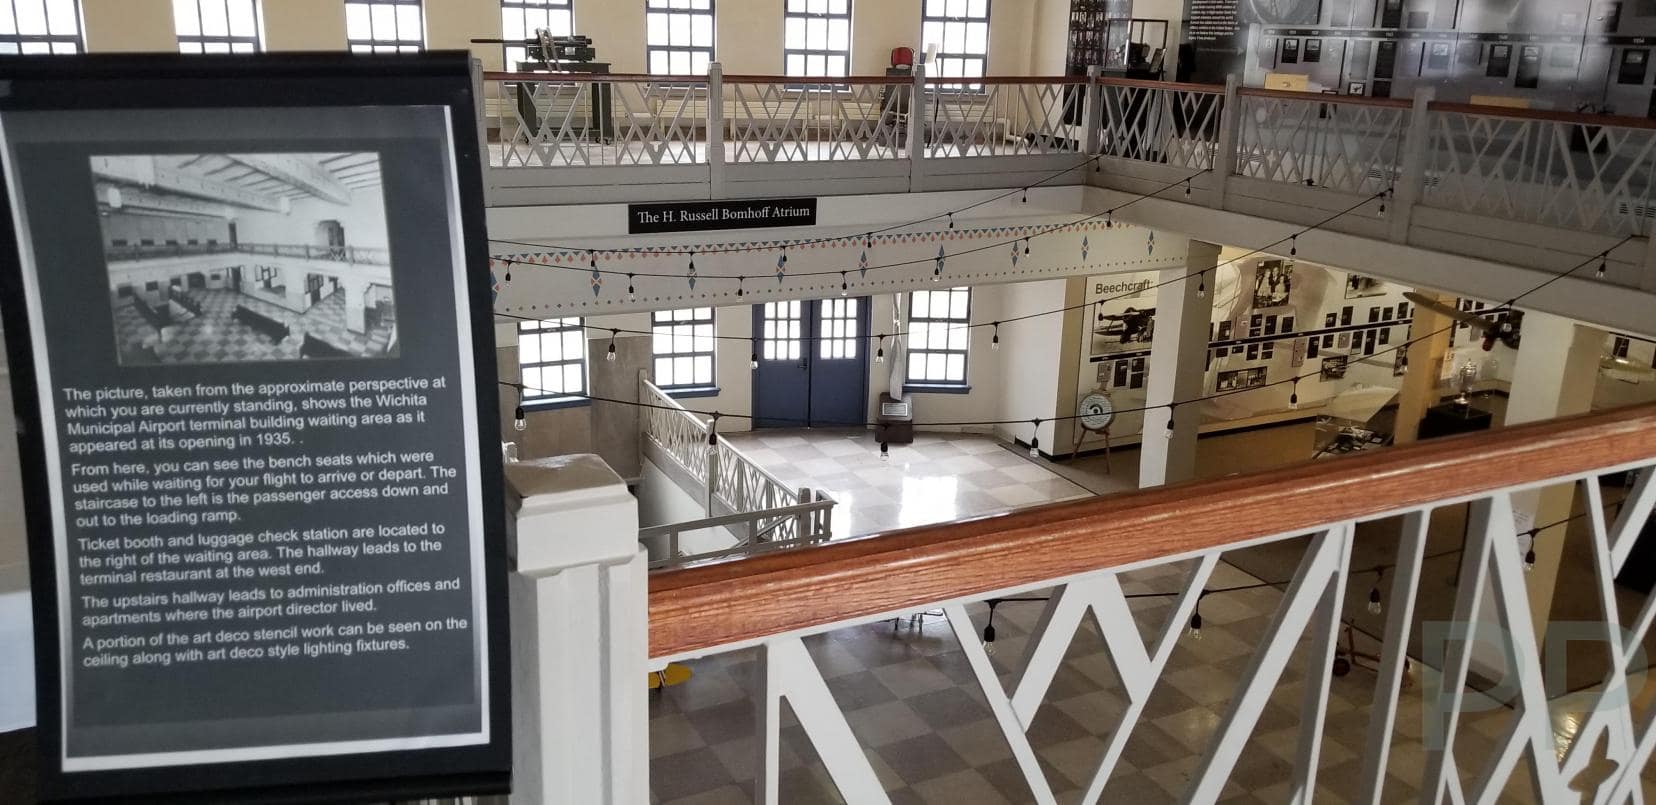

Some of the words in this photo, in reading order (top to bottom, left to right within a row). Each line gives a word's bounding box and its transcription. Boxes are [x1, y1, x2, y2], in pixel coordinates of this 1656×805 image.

[637, 211, 659, 223] The
[662, 211, 676, 223] H.
[680, 208, 719, 222] Russell
[722, 206, 771, 220] Bomhoff
[772, 206, 810, 218] Atrium
[1095, 279, 1151, 295] Beechcraft
[62, 388, 91, 400] The
[95, 387, 147, 401] picture,
[152, 386, 191, 397] taken
[195, 384, 227, 395] from
[231, 383, 254, 394] the
[258, 381, 344, 396] approximate
[349, 378, 428, 393] perspective
[432, 376, 445, 388] at
[64, 405, 106, 417] which
[110, 406, 138, 419] you
[140, 405, 164, 415] are
[167, 401, 229, 415] currently
[233, 399, 297, 413] standing,
[301, 398, 346, 409] shows
[349, 396, 372, 407] the
[375, 394, 427, 406] Wichita
[67, 422, 135, 436] Municipal
[138, 420, 185, 434] Airport
[189, 418, 245, 430] terminal
[249, 416, 304, 430] building
[307, 414, 356, 428] waiting
[361, 414, 392, 424] area
[396, 413, 412, 423] as
[416, 411, 424, 422] it
[68, 439, 137, 454] appeared
[140, 438, 155, 449] at
[158, 437, 175, 448] its
[178, 436, 236, 450] opening
[238, 434, 252, 445] in
[256, 432, 294, 444] 1935.
[70, 463, 109, 475] From
[112, 462, 149, 473] here,
[153, 462, 180, 475] you
[183, 461, 209, 471] can
[212, 460, 239, 470] see
[242, 457, 265, 468] the
[268, 455, 311, 468] bench
[315, 454, 353, 466] seats
[356, 452, 396, 464] which
[399, 452, 434, 462] were
[73, 480, 107, 492] used
[111, 479, 148, 490] while
[152, 477, 201, 491] waiting
[205, 476, 224, 487] for
[228, 476, 259, 489] your
[262, 473, 296, 487] flight
[300, 472, 313, 483] to
[317, 471, 356, 482] arrive
[360, 471, 374, 481] or
[378, 468, 425, 482] depart.
[429, 466, 456, 477] The
[74, 498, 138, 509] staircase
[142, 496, 156, 507] to
[160, 494, 182, 506] the
[186, 493, 207, 505] left
[212, 492, 223, 504] is
[227, 492, 248, 503] the
[253, 490, 325, 504] passenger
[330, 488, 378, 499] access
[382, 485, 418, 496] down
[422, 483, 448, 494] and
[76, 515, 98, 526] out
[102, 514, 116, 526] to
[119, 513, 142, 525] the
[146, 511, 198, 525] loading
[201, 511, 240, 523] ramp.
[78, 538, 120, 550] Ticket
[124, 536, 163, 548] booth
[168, 534, 193, 546] and
[198, 533, 253, 547] luggage
[258, 529, 298, 542] check
[302, 528, 347, 540] station
[352, 527, 374, 538] are
[378, 523, 427, 536] located
[432, 523, 444, 534] to
[79, 556, 101, 567] the
[105, 554, 136, 569] right
[140, 552, 154, 564] of
[157, 552, 180, 564] the
[183, 550, 233, 564] waiting
[237, 550, 271, 560] area.
[276, 546, 303, 557] The
[307, 544, 358, 557] hallway
[362, 542, 399, 554] leads
[403, 541, 416, 552] to
[420, 540, 441, 551] the
[79, 571, 136, 584] terminal
[140, 568, 211, 581] restaurant
[215, 566, 229, 578] at
[232, 566, 254, 577] the
[258, 564, 291, 576] west
[294, 562, 323, 574] end.
[81, 596, 108, 607] The
[113, 594, 168, 608] upstairs
[172, 591, 224, 604] hallway
[228, 588, 265, 600] leads
[270, 588, 283, 598] to
[287, 583, 382, 597] administration
[386, 581, 430, 592] offices
[434, 578, 459, 590] and
[82, 612, 161, 627] apartments
[165, 609, 208, 620] where
[212, 607, 233, 618] the
[238, 605, 282, 619] airport
[286, 602, 337, 614] director
[341, 600, 376, 611] lived.
[83, 637, 93, 648] A
[97, 636, 144, 650] portion
[149, 633, 162, 645] of
[167, 633, 188, 644] the
[193, 631, 211, 643] art
[215, 630, 249, 642] deco
[254, 626, 297, 640] stencil
[301, 624, 333, 637] work
[338, 625, 362, 635] can
[367, 622, 383, 634] be
[388, 621, 420, 632] seen
[425, 620, 441, 630] on
[446, 618, 467, 629] the
[83, 653, 128, 668] ceiling
[132, 652, 170, 665] along
[174, 649, 203, 661] with
[207, 648, 226, 660] art
[229, 647, 264, 658] deco
[267, 644, 299, 659] style
[303, 642, 352, 657] lighting
[356, 639, 409, 651] fixtures.
